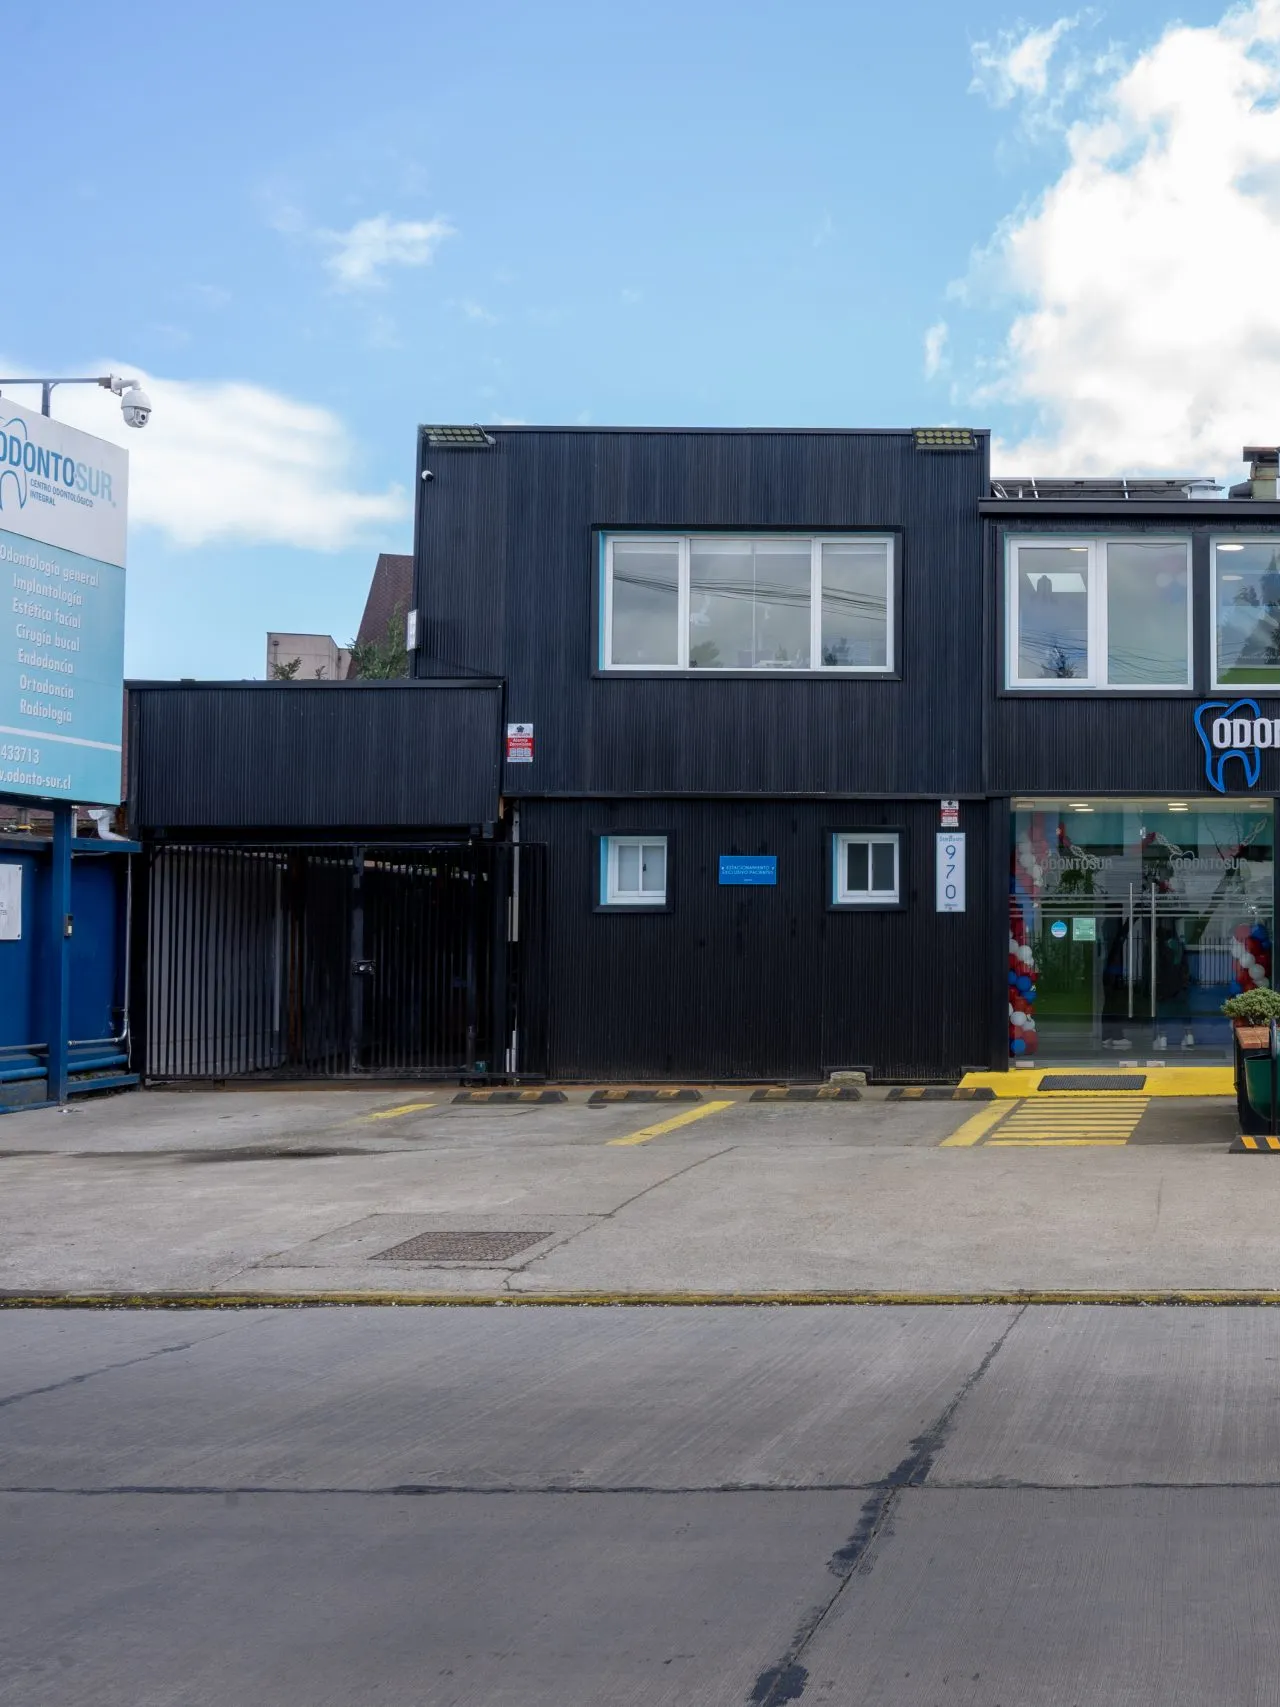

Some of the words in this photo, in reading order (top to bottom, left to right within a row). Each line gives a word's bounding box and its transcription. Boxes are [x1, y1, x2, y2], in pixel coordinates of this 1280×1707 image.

[30, 478, 51, 493] CENTRO
[30, 490, 56, 506] INTEGRAL
[0, 544, 60, 577] Odontología
[63, 568, 99, 587] general
[13, 572, 82, 607] Implantología
[13, 597, 52, 621] Estética
[54, 608, 81, 629] facial
[16, 623, 52, 647] Cirugía
[55, 631, 80, 651] bucal
[18, 647, 74, 674] Endodoncia
[19, 674, 74, 699] Ortodoncia
[20, 698, 72, 725] Radiología
[945, 844, 957, 900] 970
[1041, 857, 1113, 870] ODONTOSUR
[1174, 857, 1248, 870] ODONTOSUR
